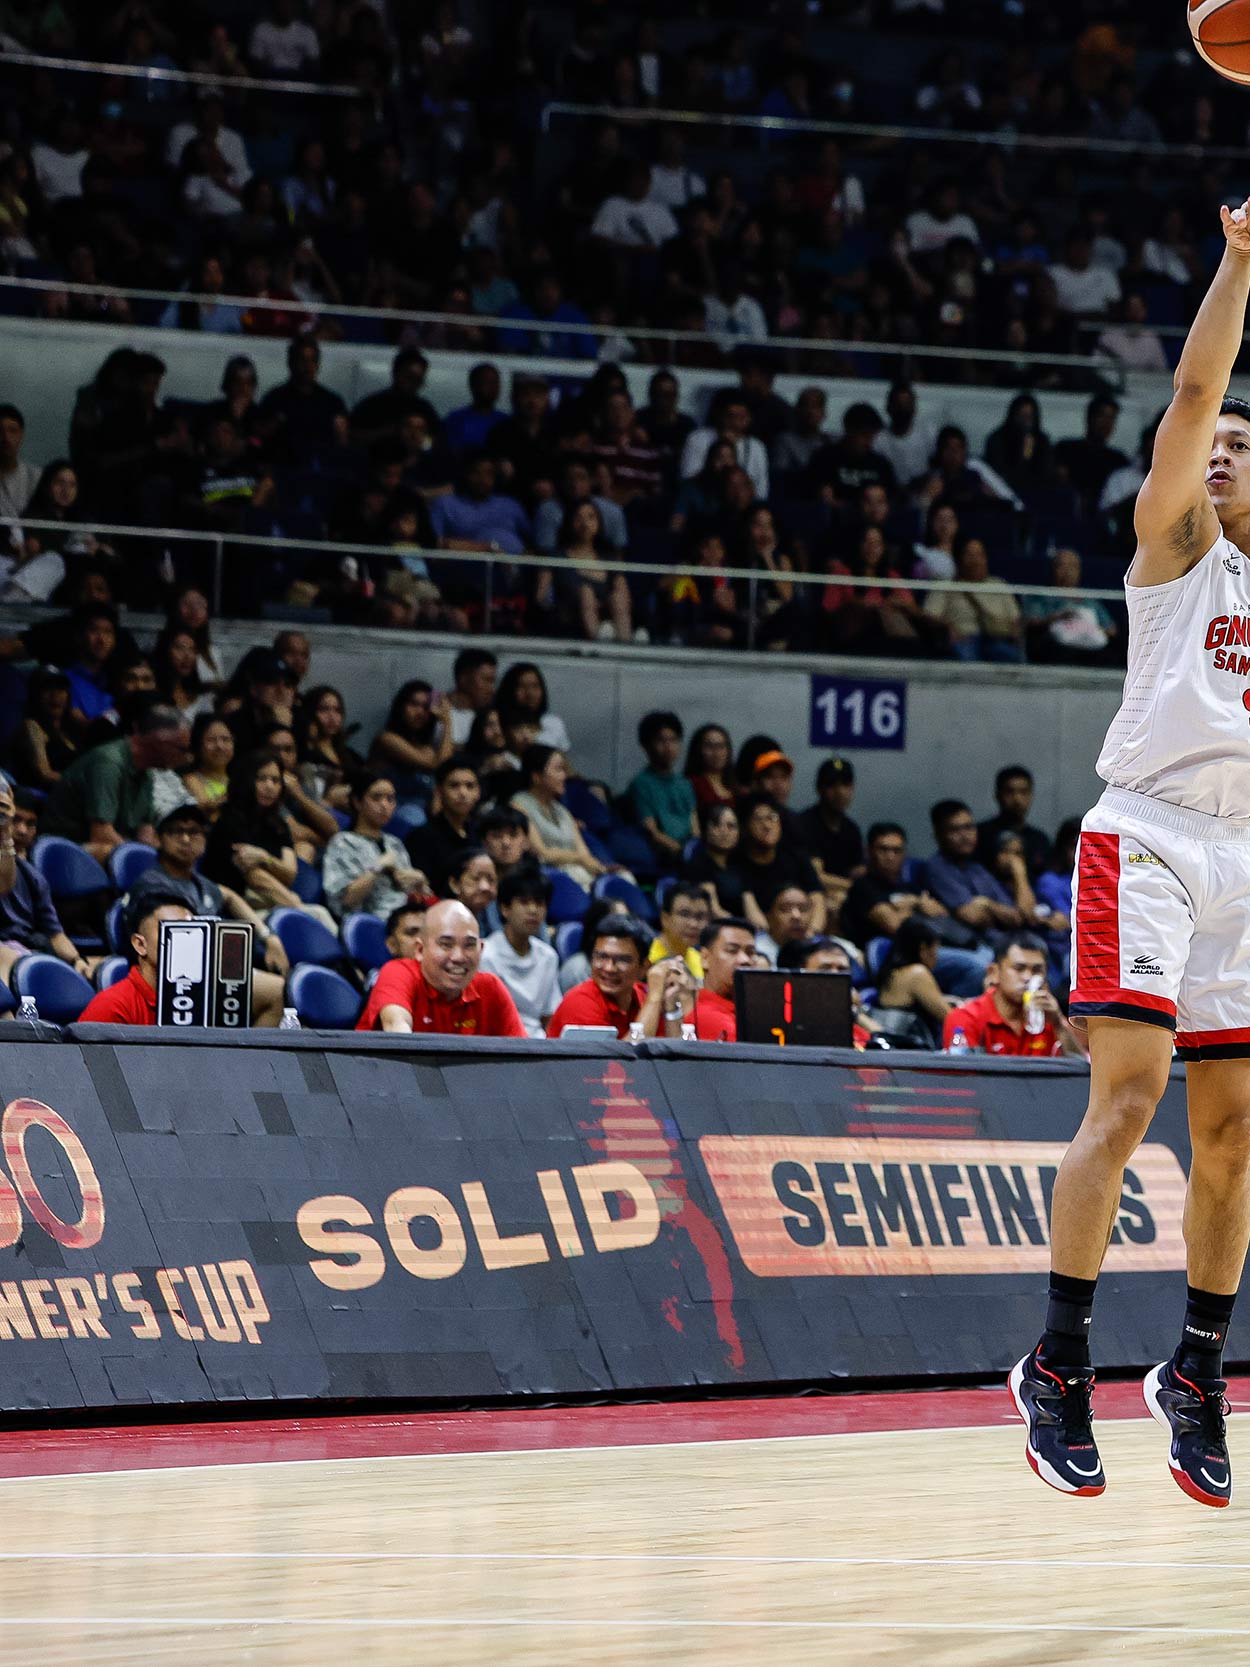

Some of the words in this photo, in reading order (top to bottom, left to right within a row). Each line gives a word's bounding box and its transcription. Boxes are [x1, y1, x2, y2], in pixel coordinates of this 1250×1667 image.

[816, 688, 900, 738] 116
[783, 981, 793, 1023] 1
[296, 1161, 661, 1291] SOLID
[771, 1160, 1157, 1247] SEMIFINS
[155, 1259, 271, 1344] CUP
